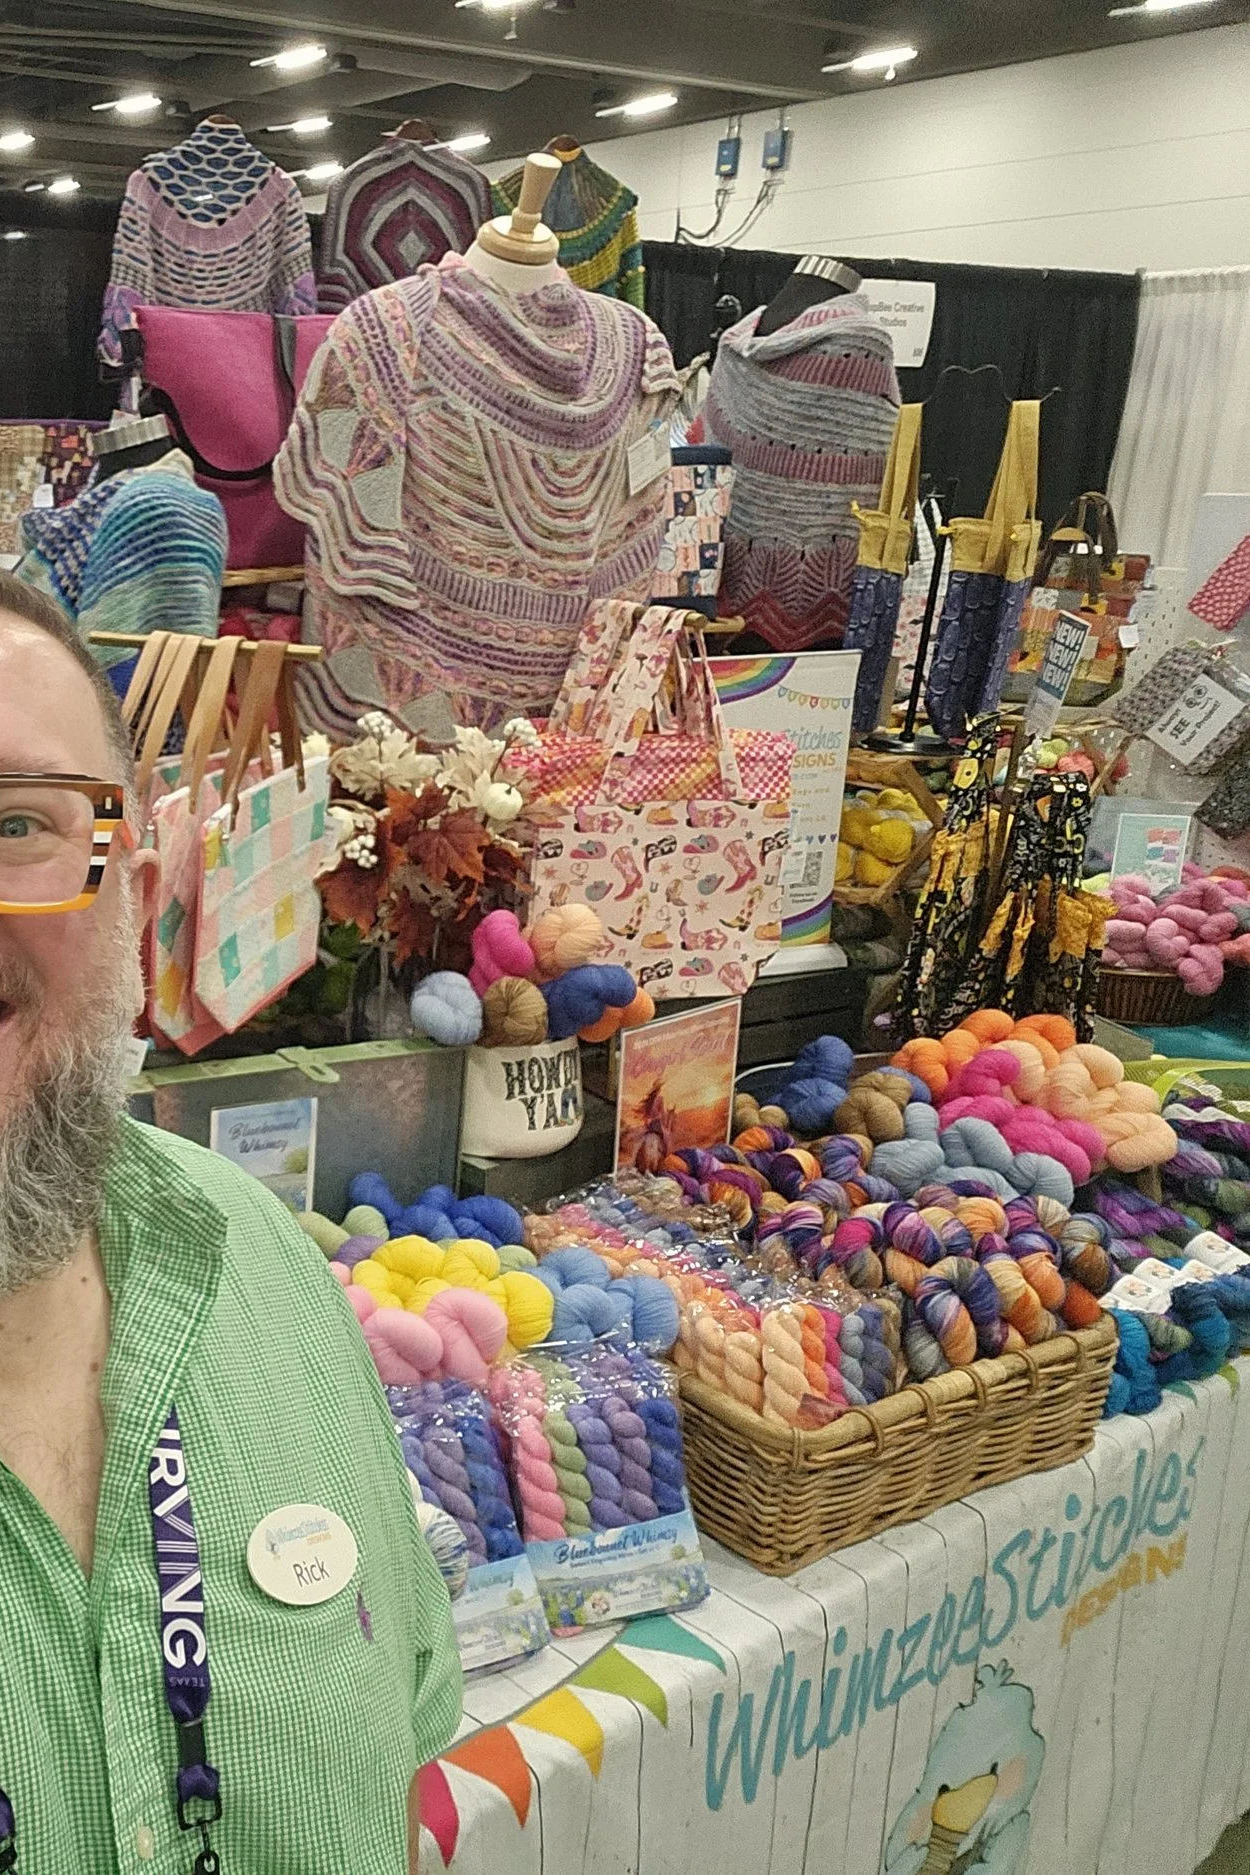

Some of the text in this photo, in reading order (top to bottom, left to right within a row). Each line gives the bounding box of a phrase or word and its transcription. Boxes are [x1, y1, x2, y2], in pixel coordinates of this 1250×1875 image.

[1170, 718, 1190, 739] SEE
[1179, 730, 1198, 746] Your
[792, 752, 837, 769] SIGNS
[150, 1428, 207, 1669] IRVING
[292, 1555, 331, 1588] Rick
